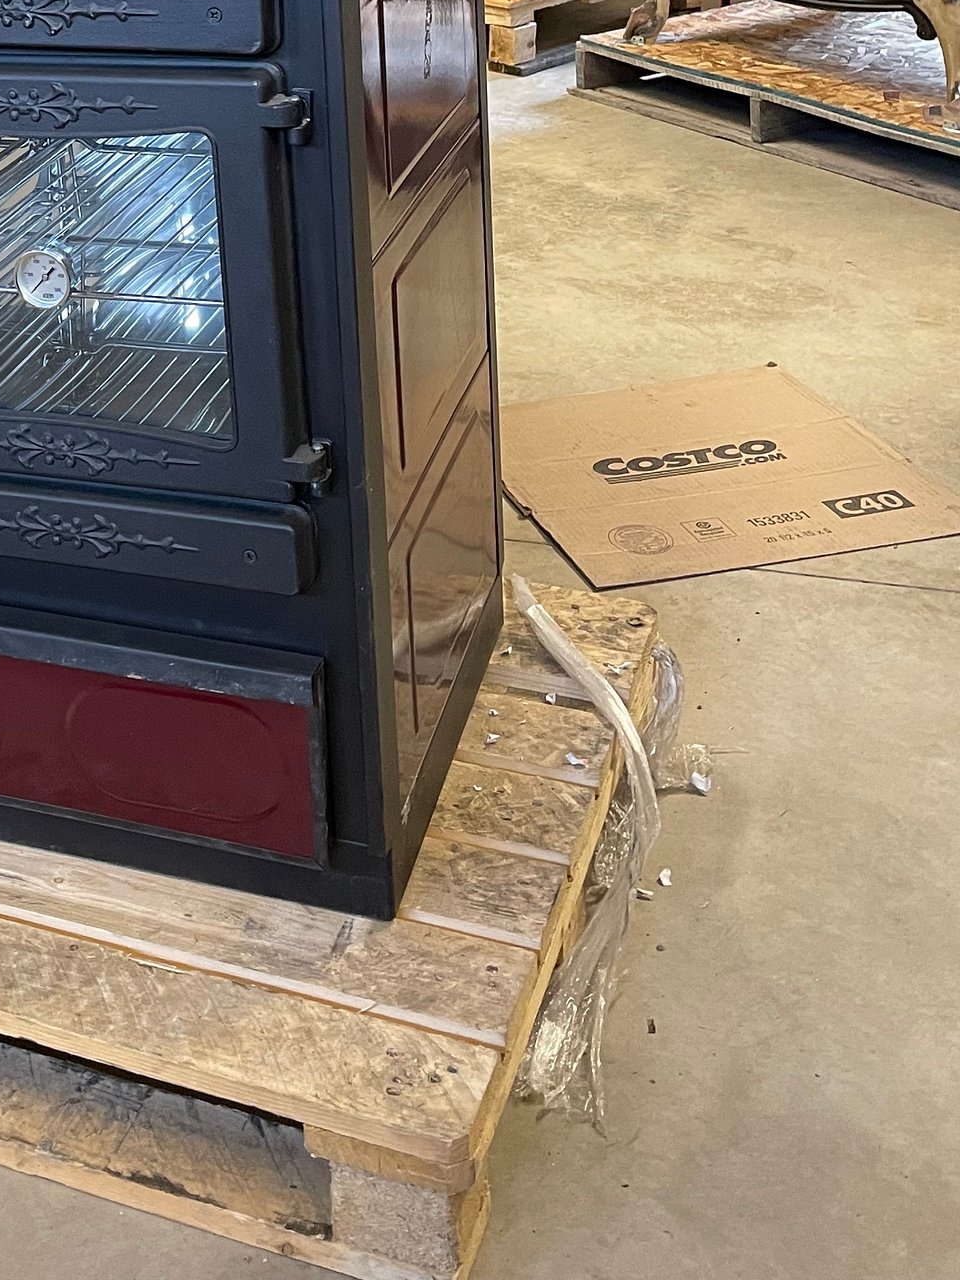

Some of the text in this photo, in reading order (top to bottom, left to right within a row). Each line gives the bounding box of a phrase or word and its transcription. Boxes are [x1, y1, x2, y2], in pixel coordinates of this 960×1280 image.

[593, 439, 777, 476] COSTCO
[835, 493, 904, 515] C40
[746, 510, 811, 527] 1533831
